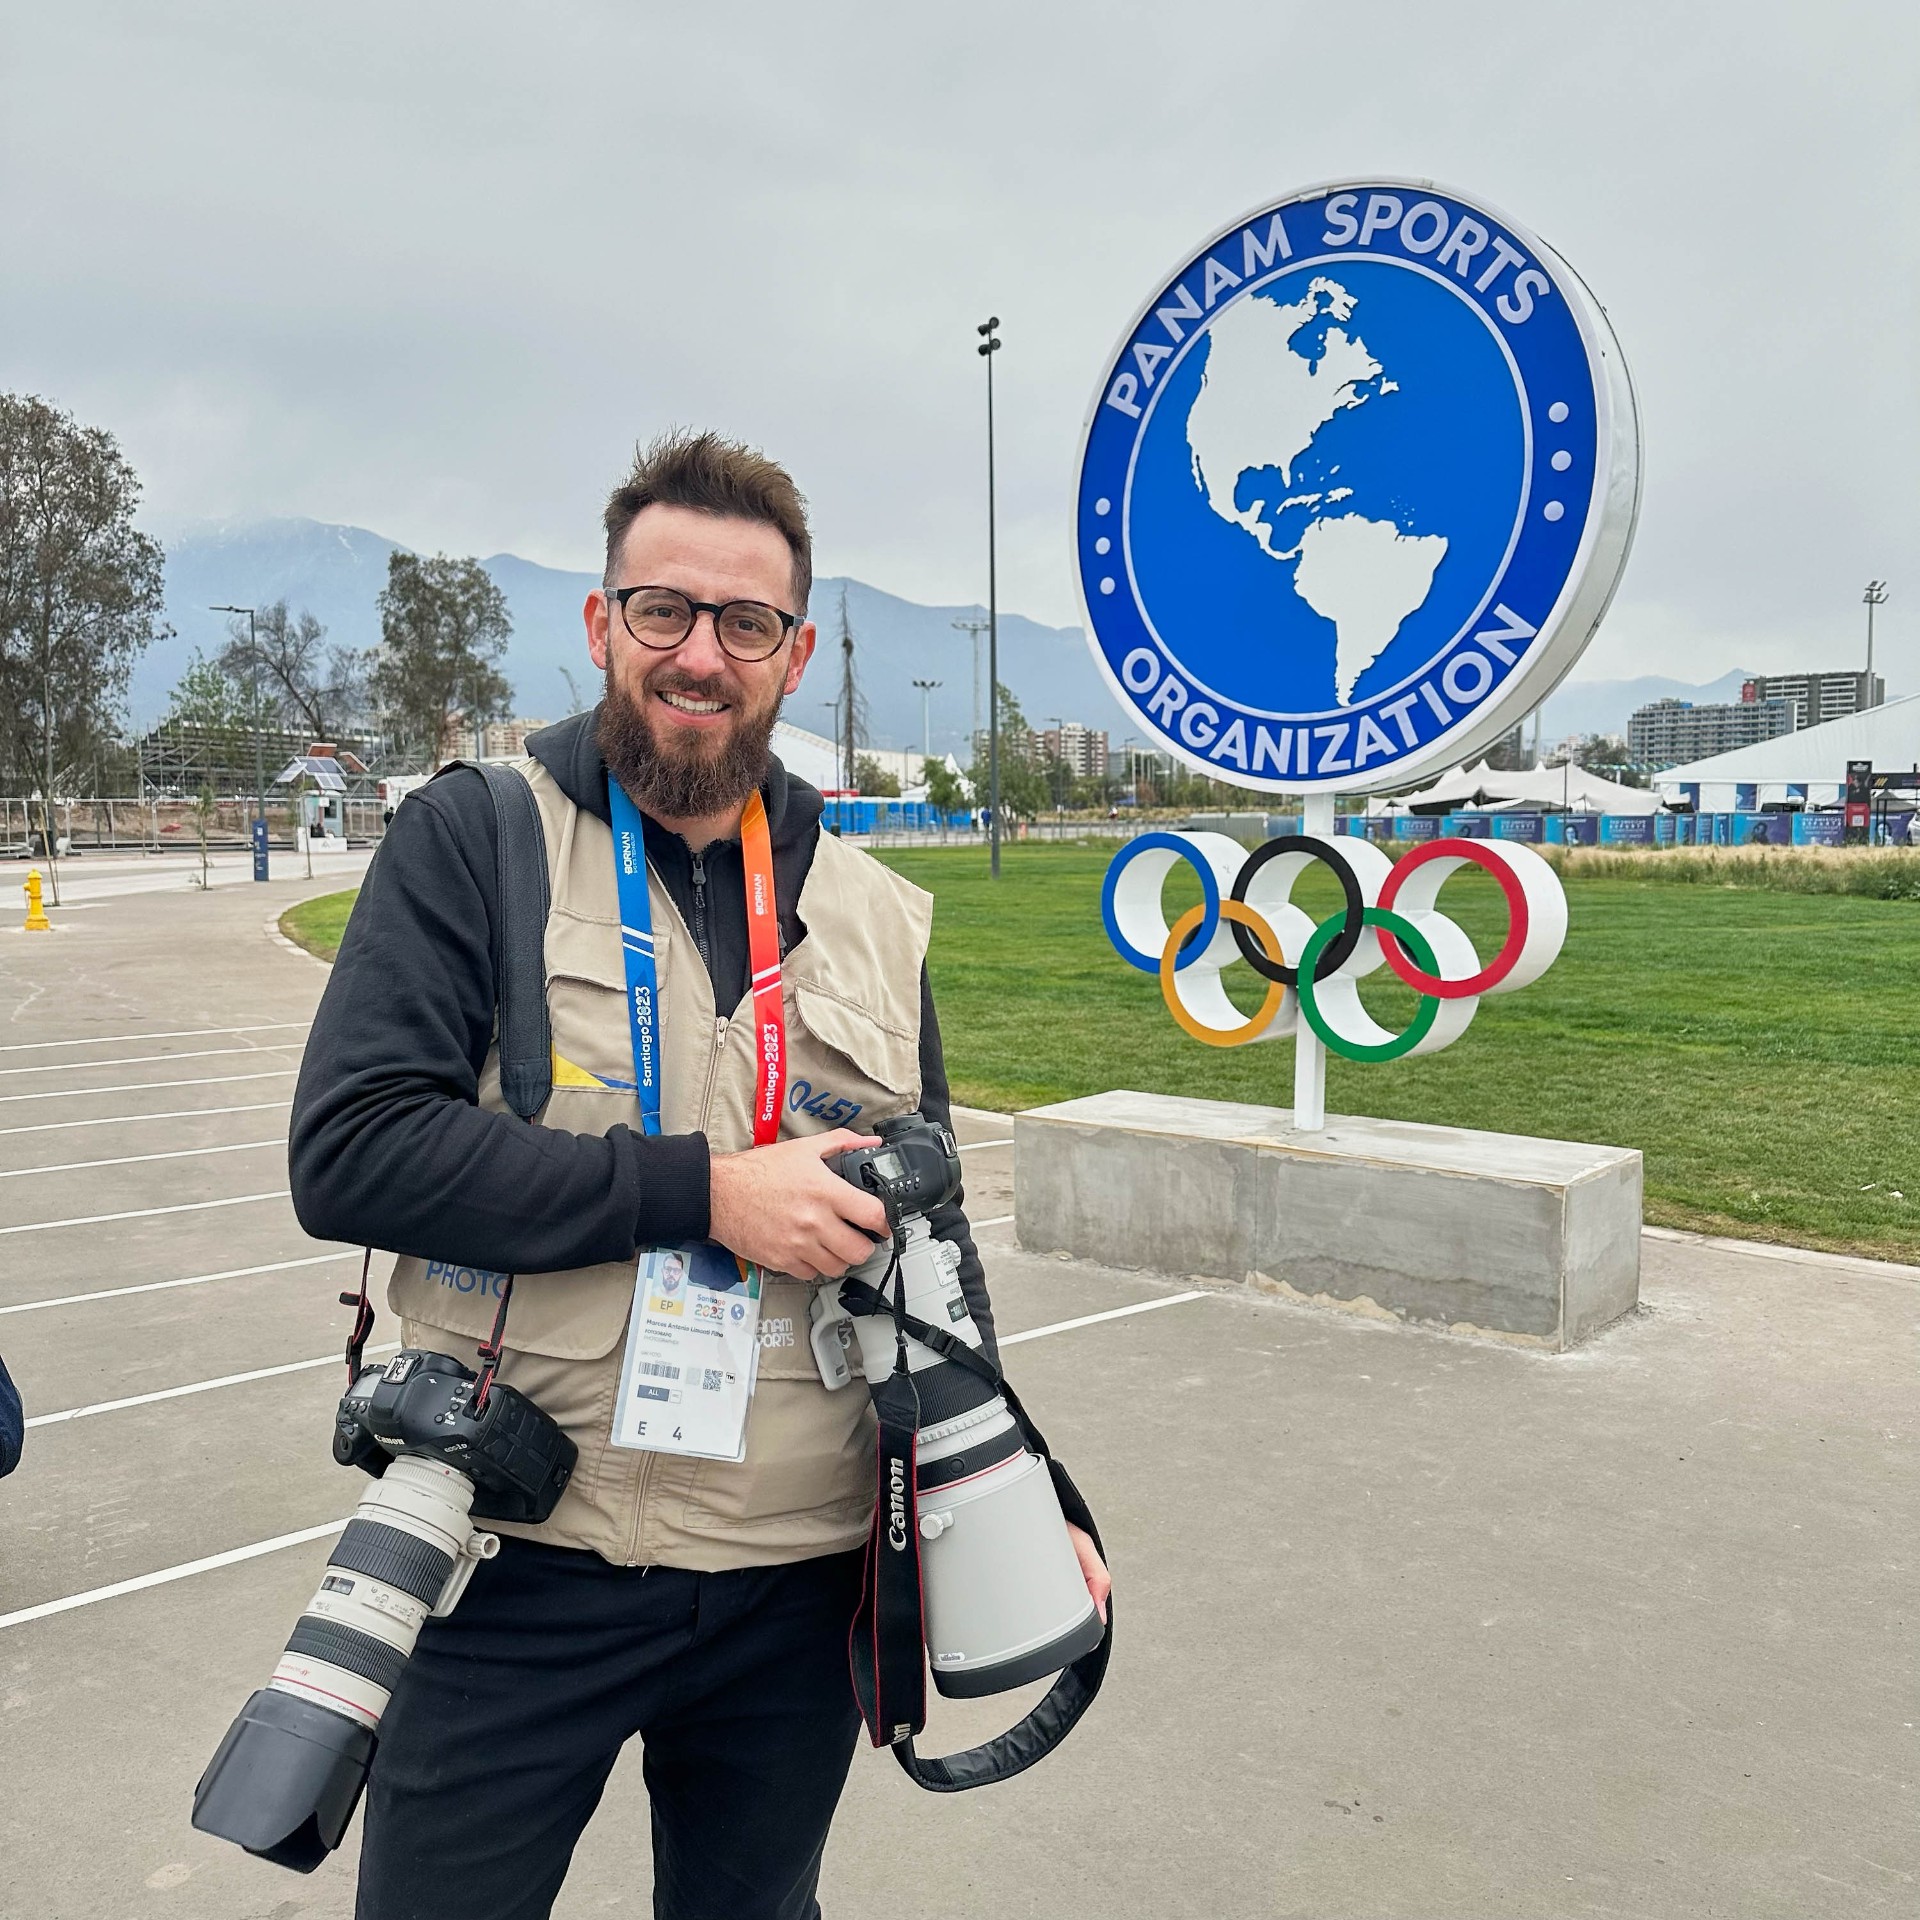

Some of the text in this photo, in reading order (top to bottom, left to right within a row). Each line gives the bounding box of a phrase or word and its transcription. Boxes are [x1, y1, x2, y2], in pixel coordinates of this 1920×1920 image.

[1105, 194, 1550, 419] PANAM SPORTS
[1121, 602, 1539, 774] ORGANIZATION
[621, 831, 633, 875] BORNAN
[753, 873, 765, 916] BORNAN
[789, 1080, 863, 1127] 0451
[425, 1260, 513, 1299] PHOTO
[660, 1300, 674, 1310] EP
[694, 1303, 725, 1320] 2023
[696, 1294, 726, 1306] Santiago
[757, 1317, 793, 1333] ANAM
[648, 1388, 659, 1396] ALL
[374, 1434, 406, 1445] Canon
[637, 1421, 683, 1441] E 4
[889, 1457, 907, 1551] Canon
